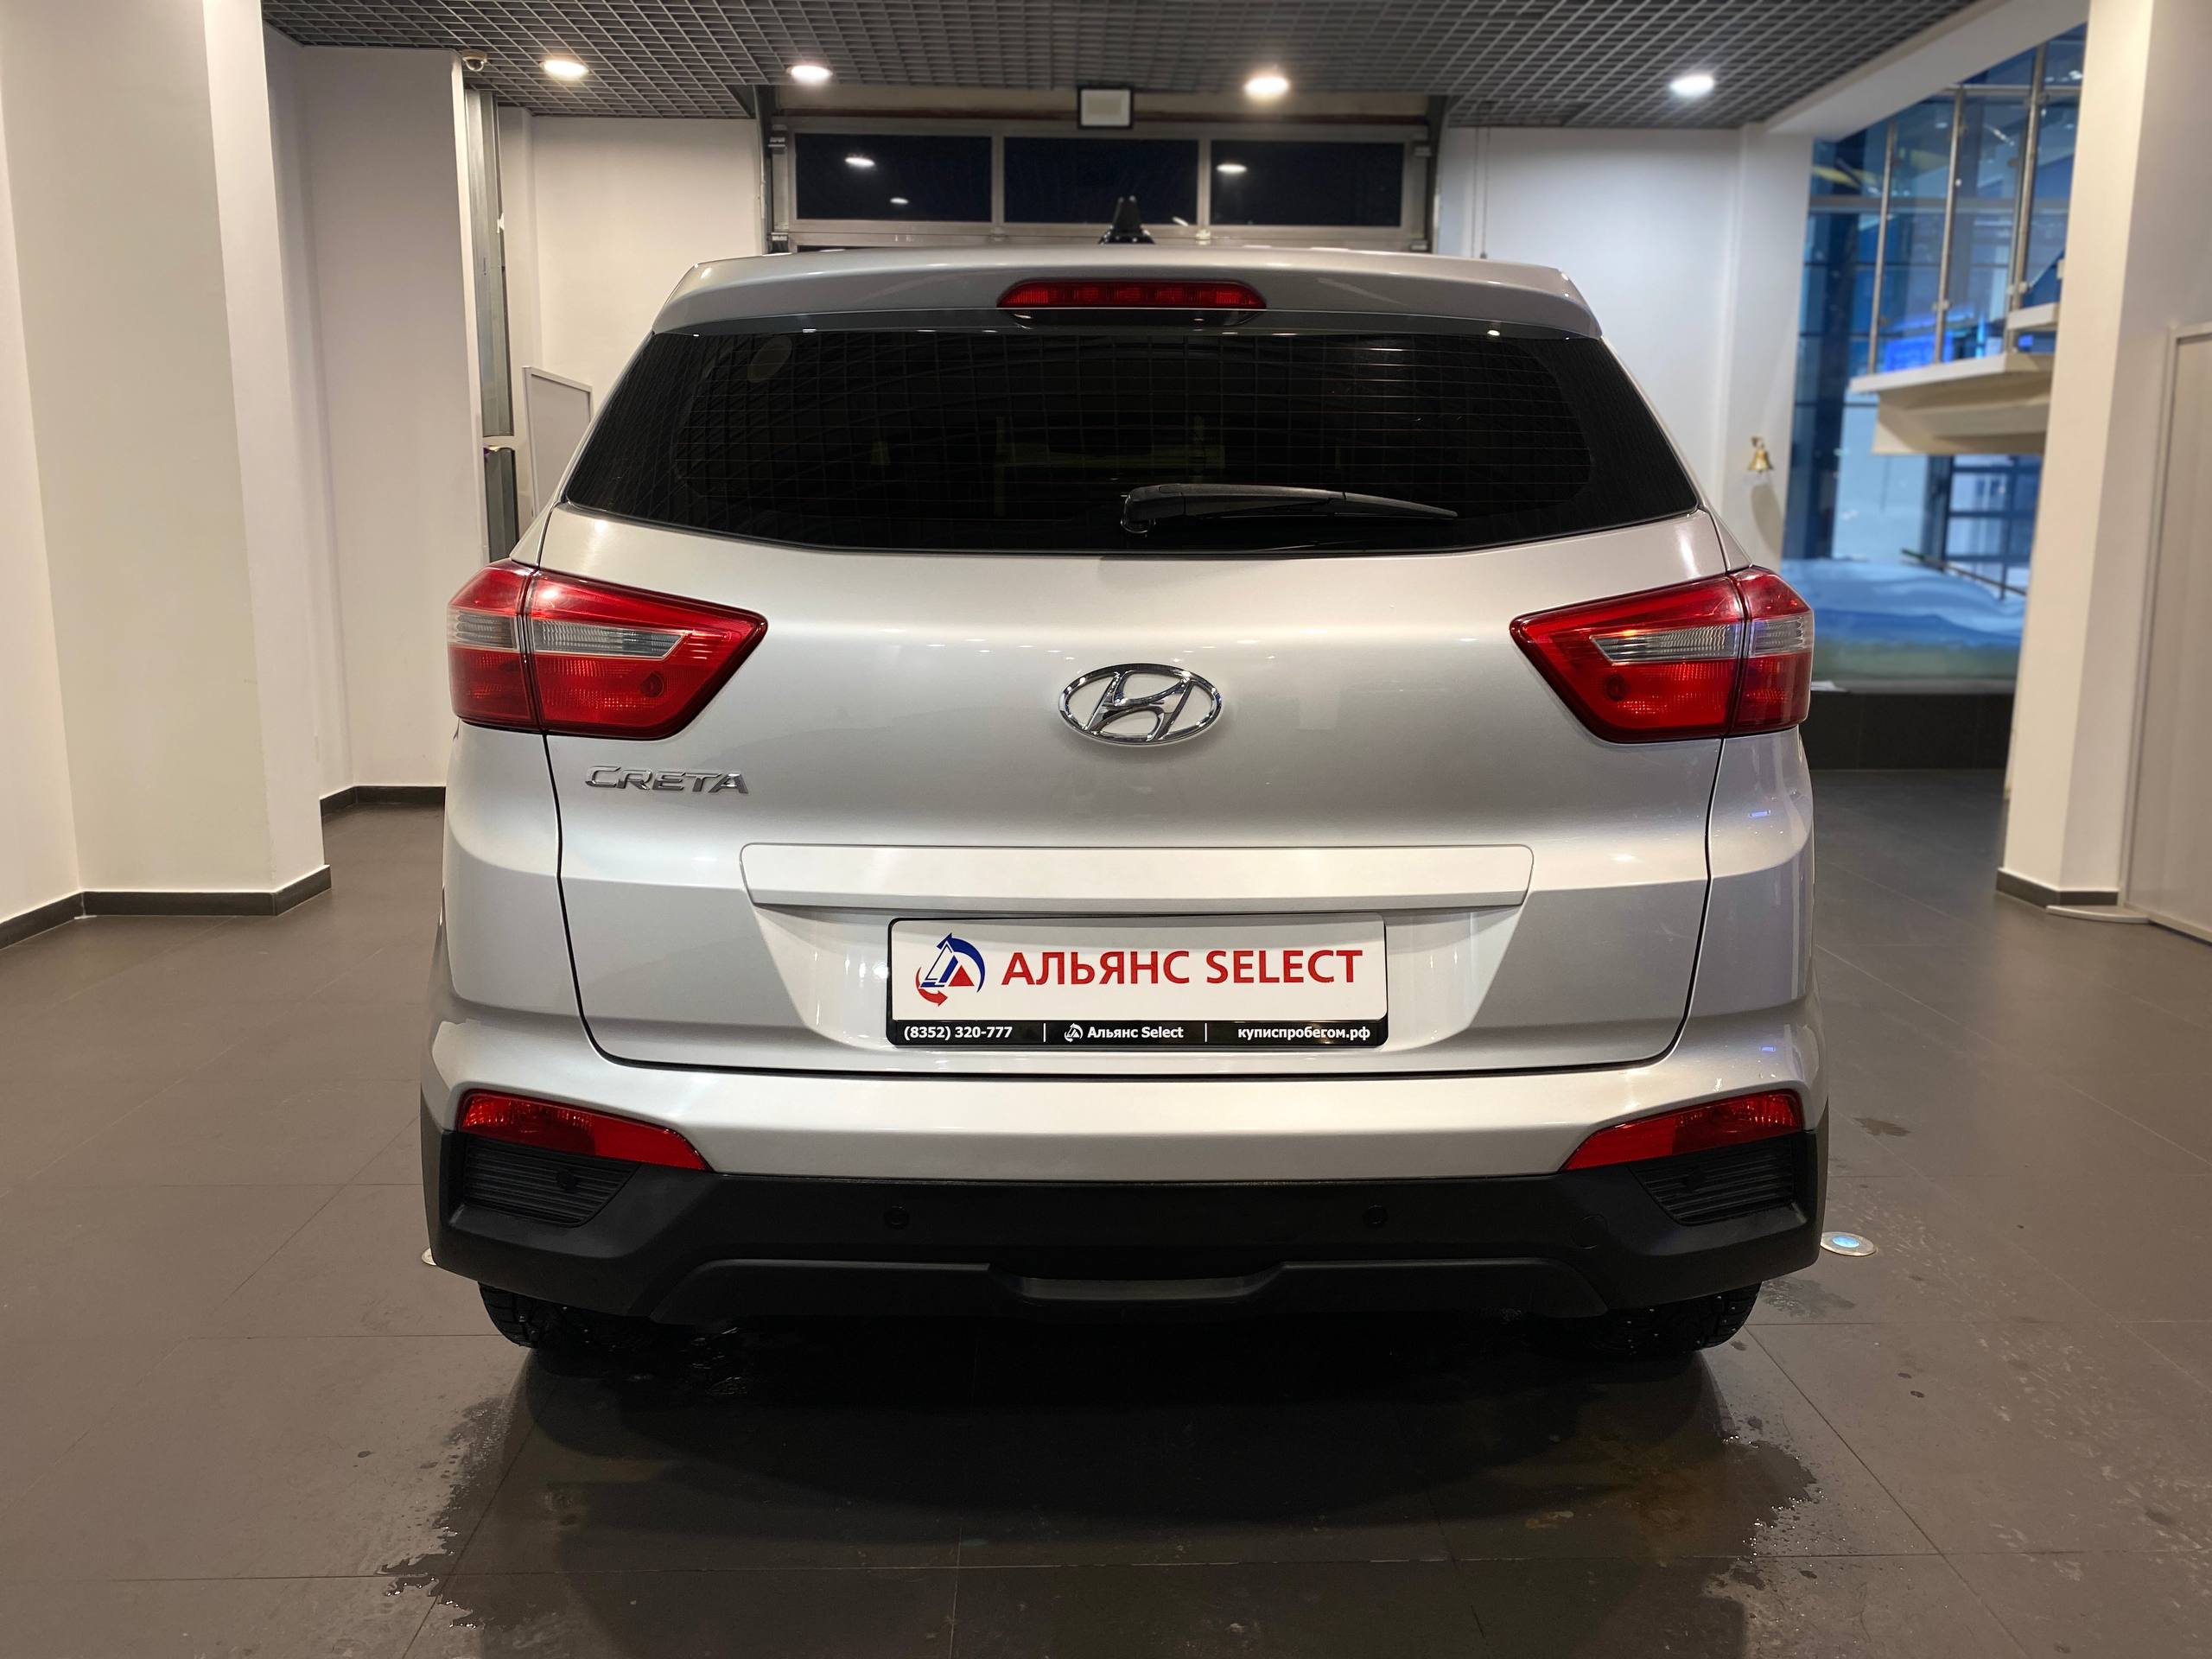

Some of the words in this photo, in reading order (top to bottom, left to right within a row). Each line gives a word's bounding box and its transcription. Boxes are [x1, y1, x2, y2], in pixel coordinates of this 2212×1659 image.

[585, 766, 749, 794] CRETA
[1001, 950, 1190, 986] АЛЬЯНС
[1205, 949, 1363, 984] SELECT
[904, 1026, 951, 1041] (8352)
[955, 1026, 1013, 1039] 320-777
[1087, 1026, 1139, 1039] Альянс
[1141, 1026, 1184, 1039] Select
[1237, 1027, 1370, 1042] куписпробегом.рф
